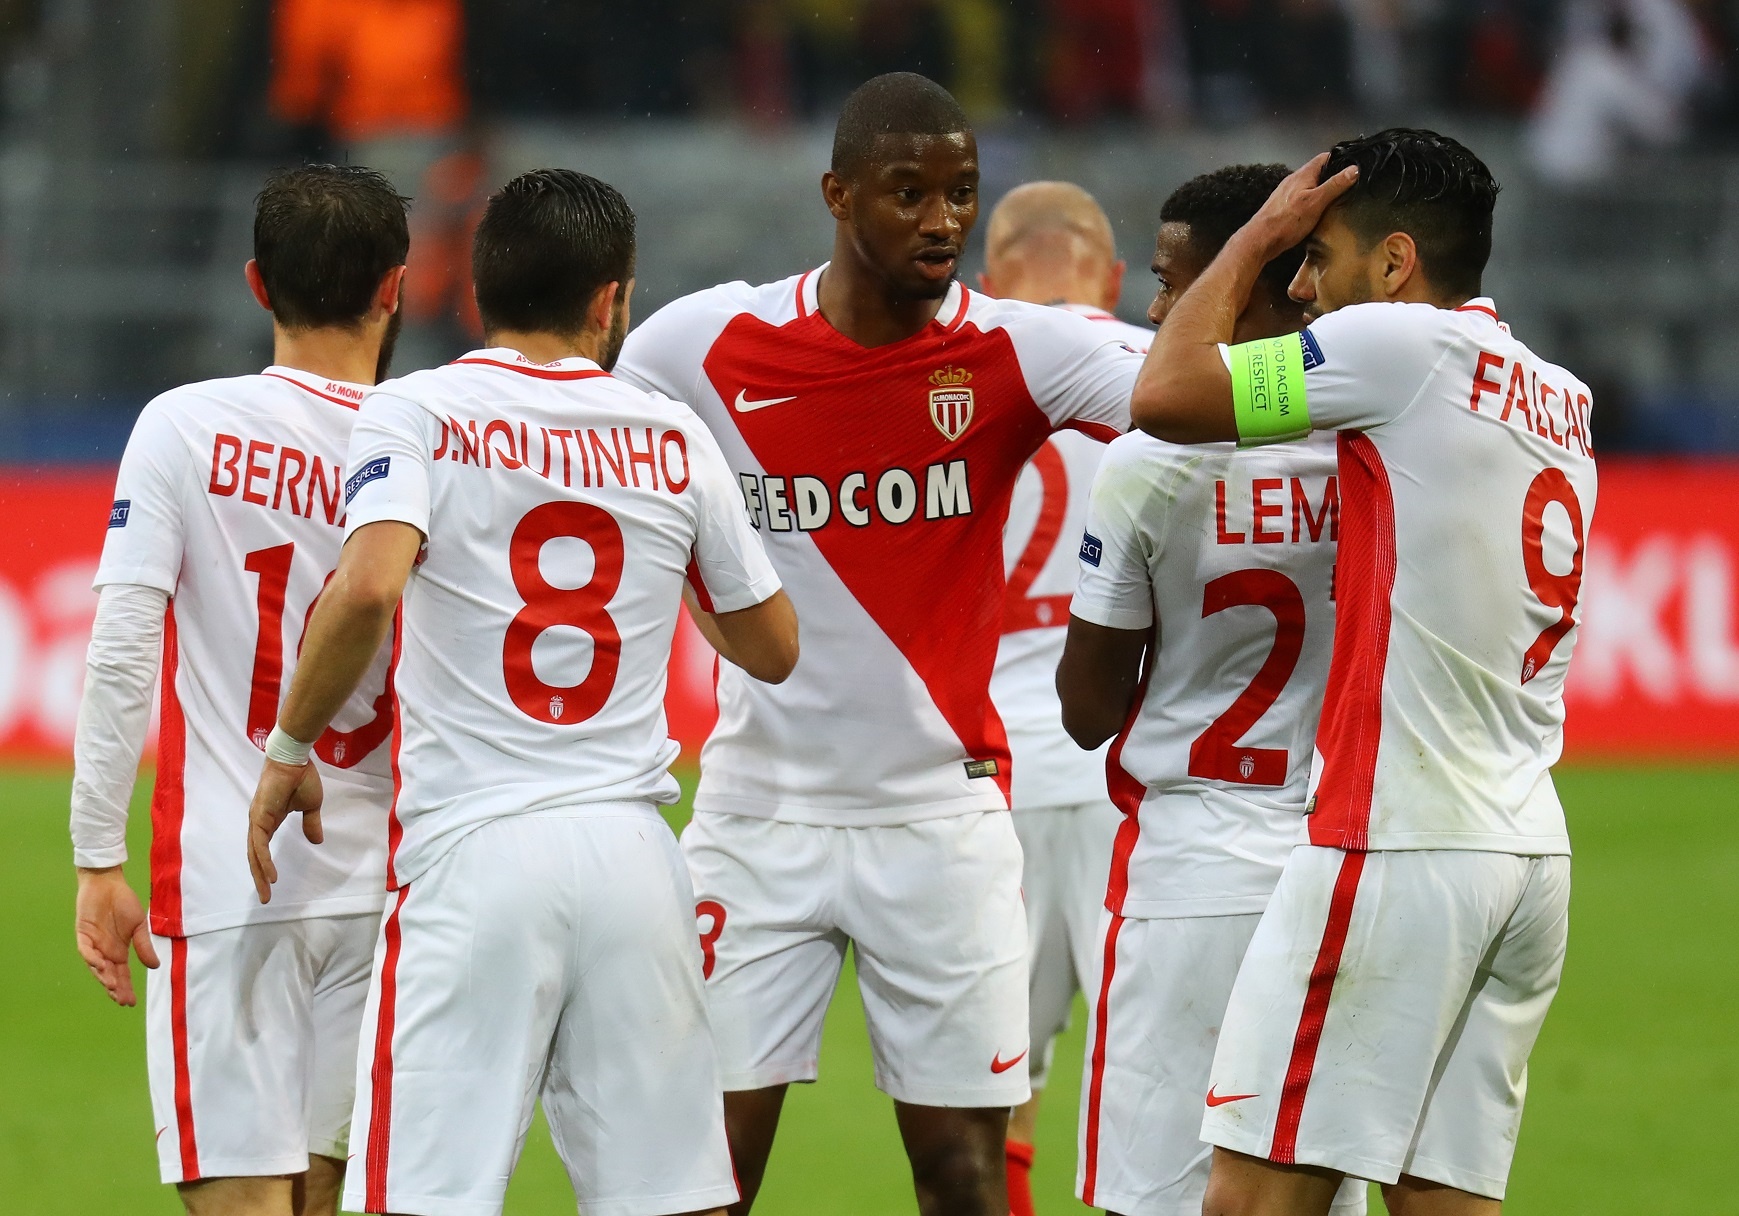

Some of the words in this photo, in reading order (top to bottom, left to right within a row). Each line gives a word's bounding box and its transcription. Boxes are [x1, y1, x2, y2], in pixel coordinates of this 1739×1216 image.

[325, 382, 337, 393] AS
[1252, 353, 1267, 412] RESPECT
[1274, 349, 1285, 363] TO
[1274, 364, 1290, 417] RACISM
[1469, 350, 1595, 460] FALCAO
[208, 433, 347, 528] BERN
[346, 462, 389, 498] RESPECT
[739, 459, 972, 533] FEDCOM
[1521, 467, 1585, 687] 9
[502, 500, 625, 726] 8
